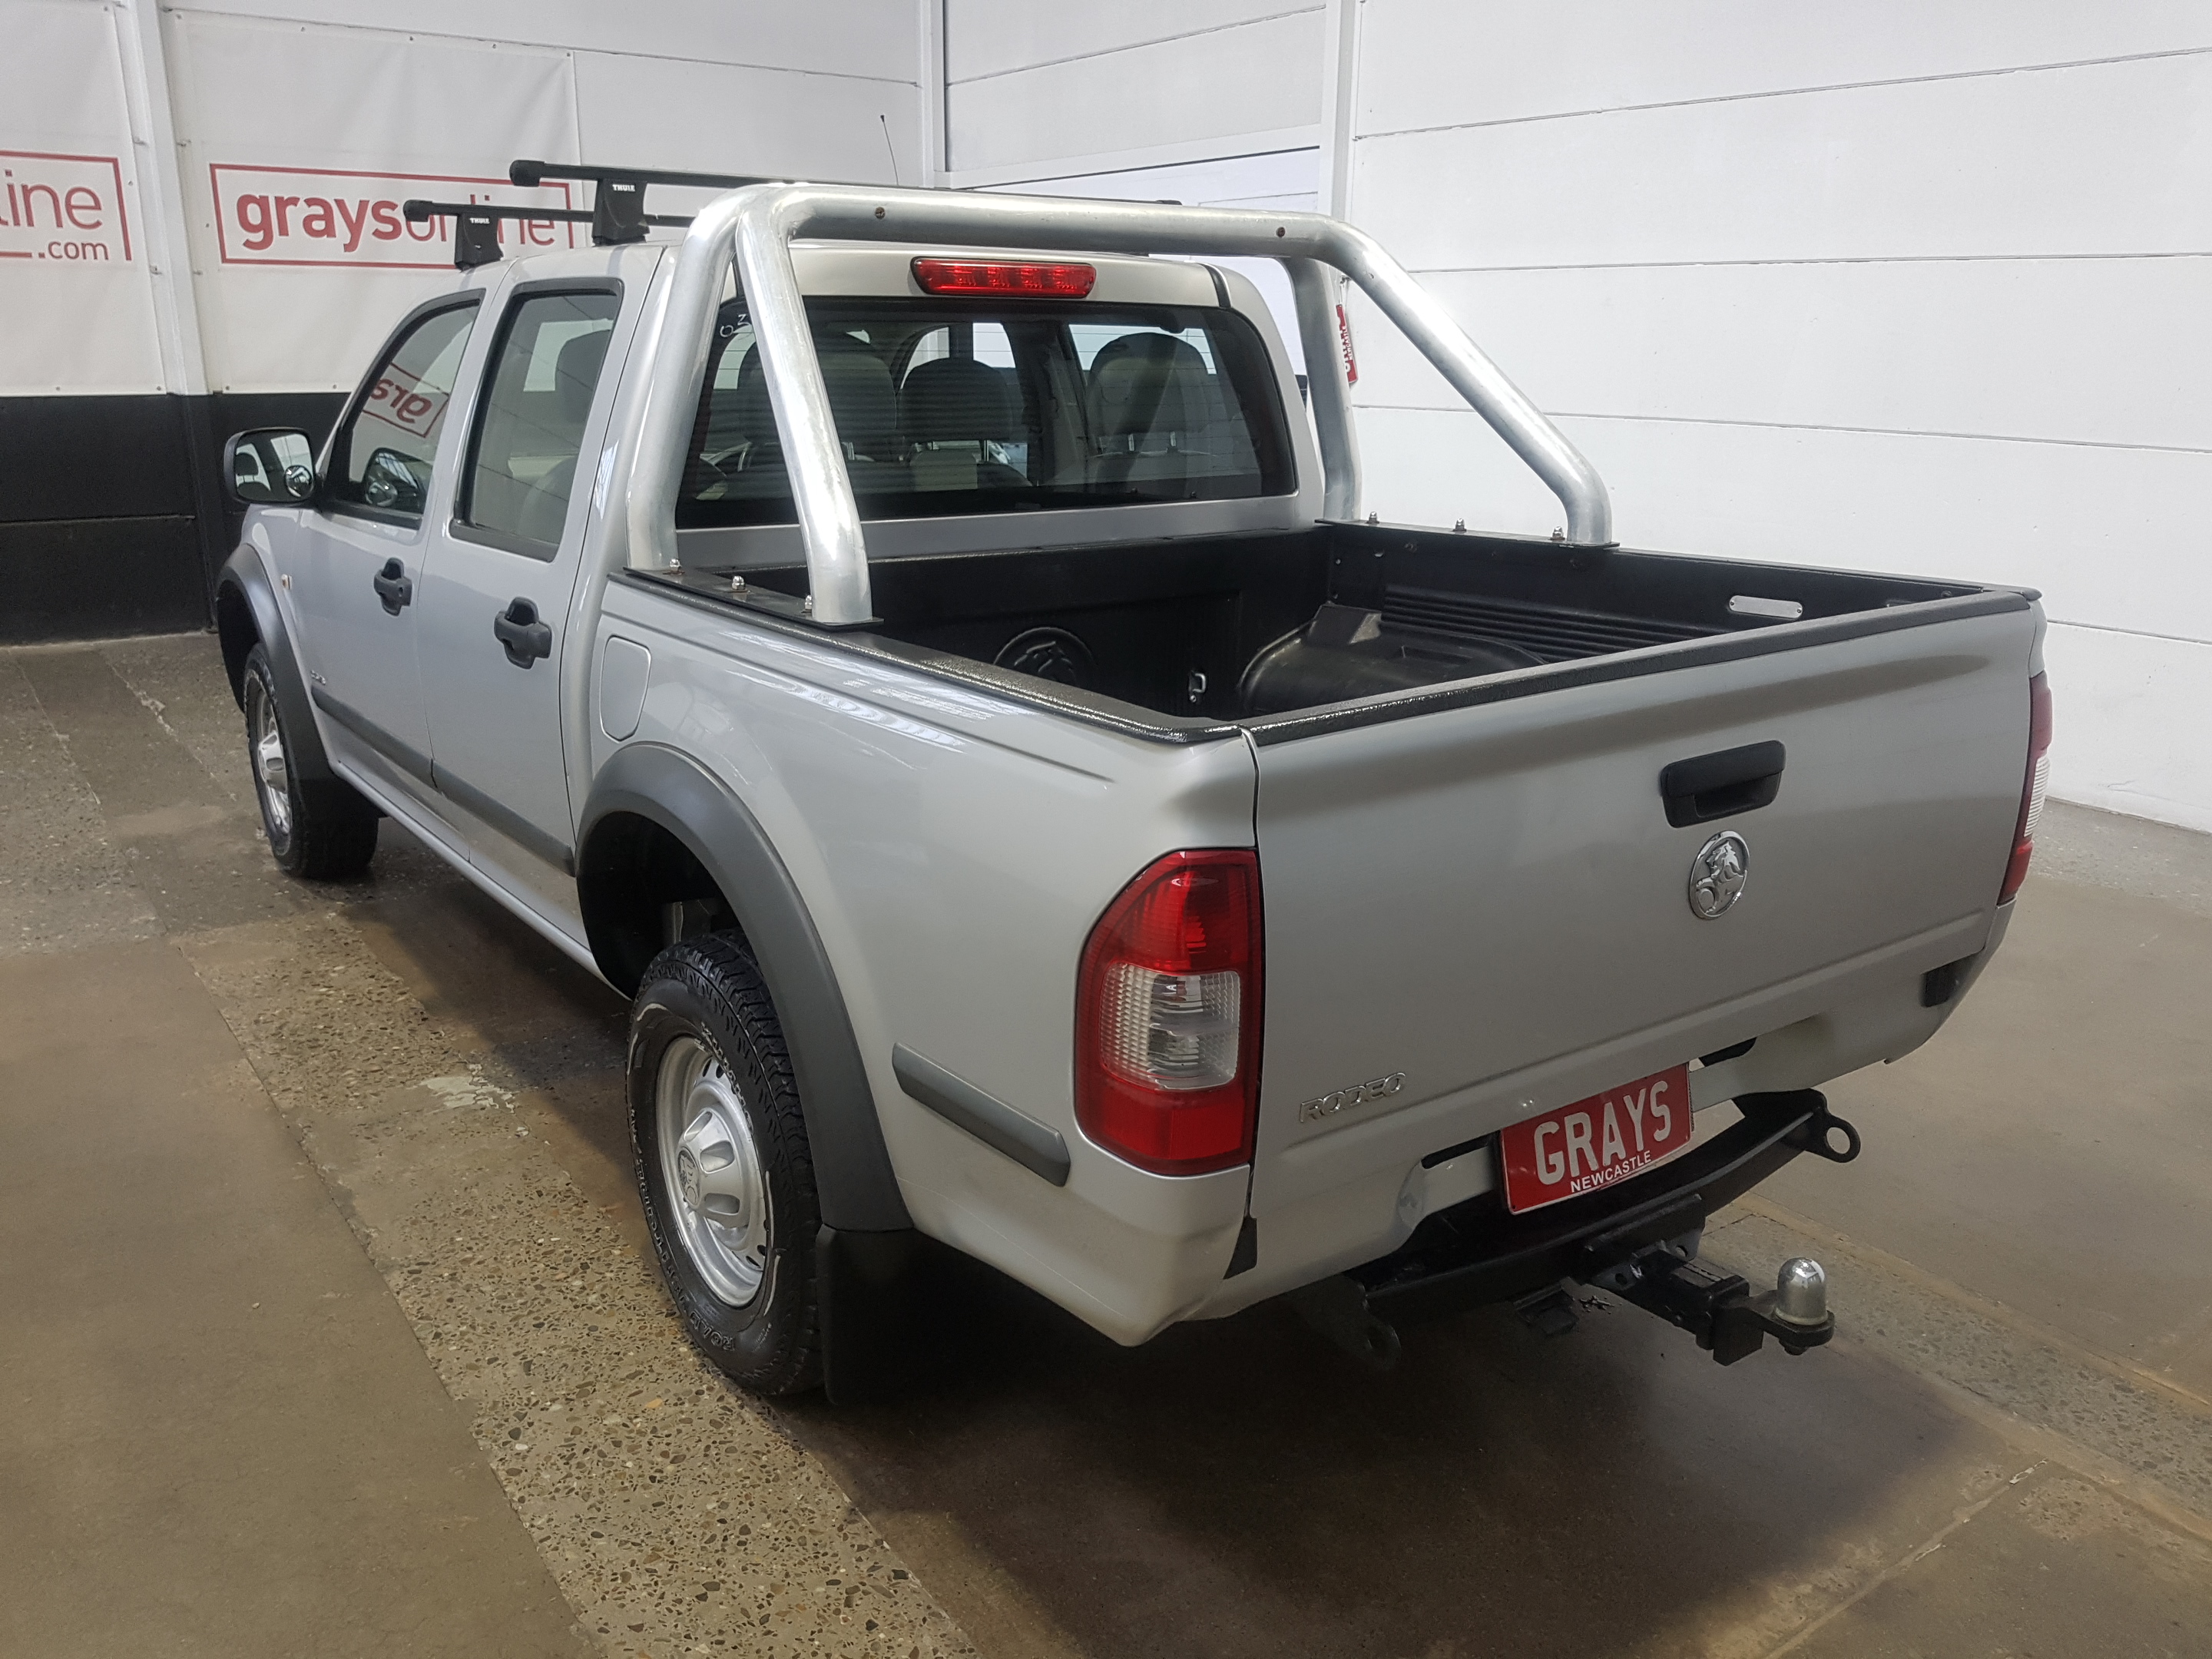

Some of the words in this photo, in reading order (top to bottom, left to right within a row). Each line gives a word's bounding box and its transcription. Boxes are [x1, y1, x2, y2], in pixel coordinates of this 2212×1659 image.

[0, 169, 102, 230] ine
[612, 184, 635, 192] THULE
[38, 241, 108, 260] .com
[1299, 1072, 1406, 1123] RODEO
[1534, 1080, 1671, 1185] GRAYS
[1570, 1150, 1651, 1193] NEWCASTLE
